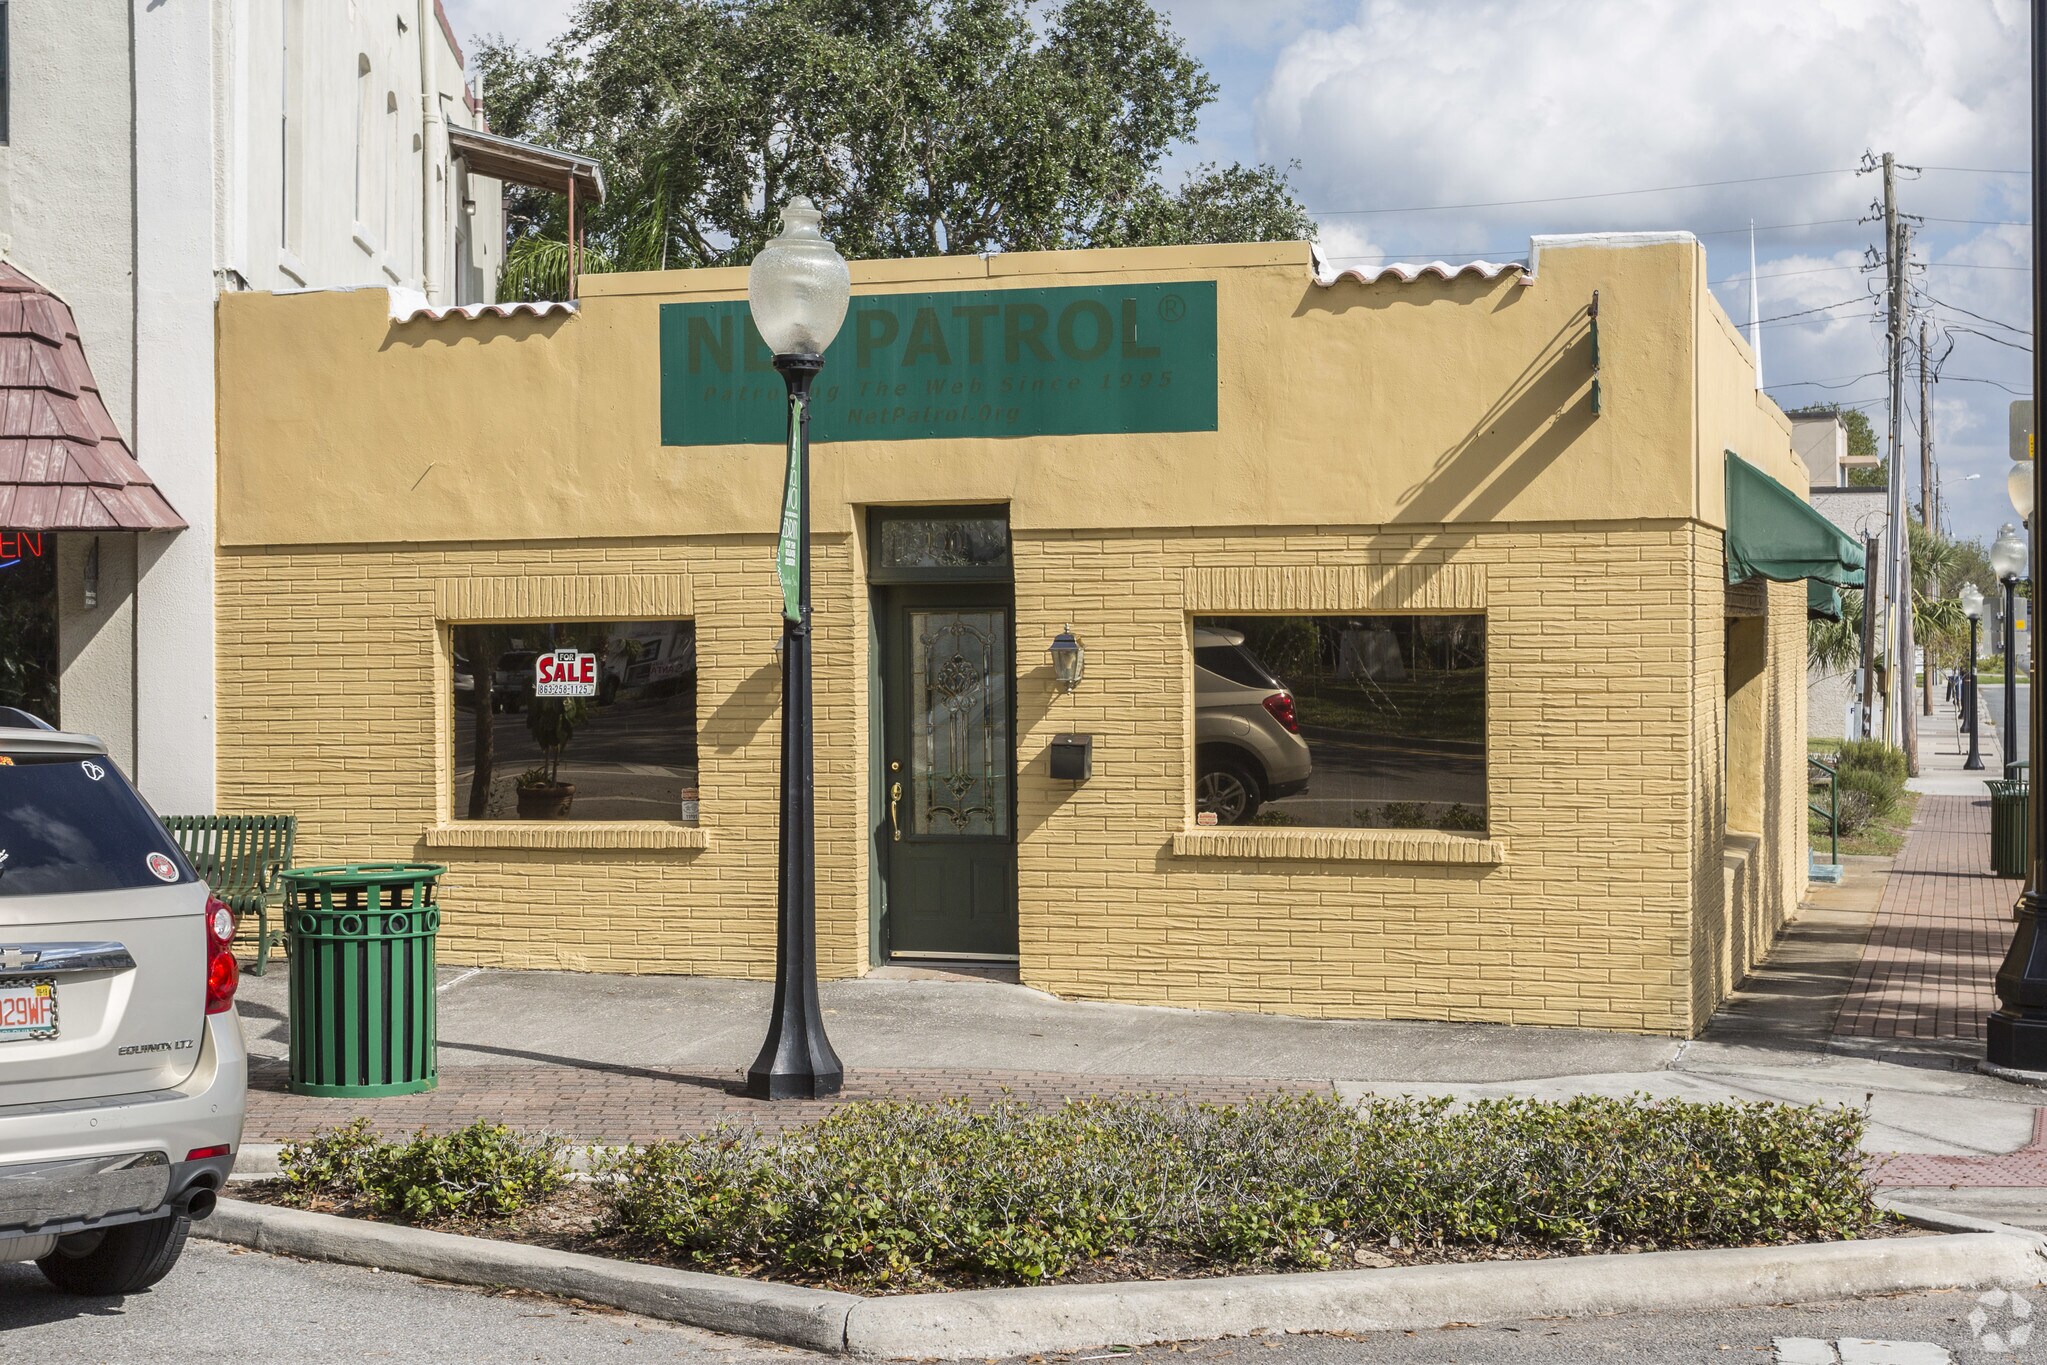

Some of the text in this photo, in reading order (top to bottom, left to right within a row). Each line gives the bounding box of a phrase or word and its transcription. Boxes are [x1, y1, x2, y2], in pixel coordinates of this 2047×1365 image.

[858, 378, 908, 397] The
[927, 376, 983, 395] Web
[1000, 374, 1081, 393] Since
[1101, 370, 1173, 389] 1995
[847, 403, 1022, 425] NetPatrol.Org
[559, 653, 575, 661] FOR
[539, 656, 595, 684] SALE
[539, 684, 588, 694] 863-258-1125
[0, 996, 51, 1026] 29WF
[118, 1039, 194, 1056] EQUINOX LTZ
